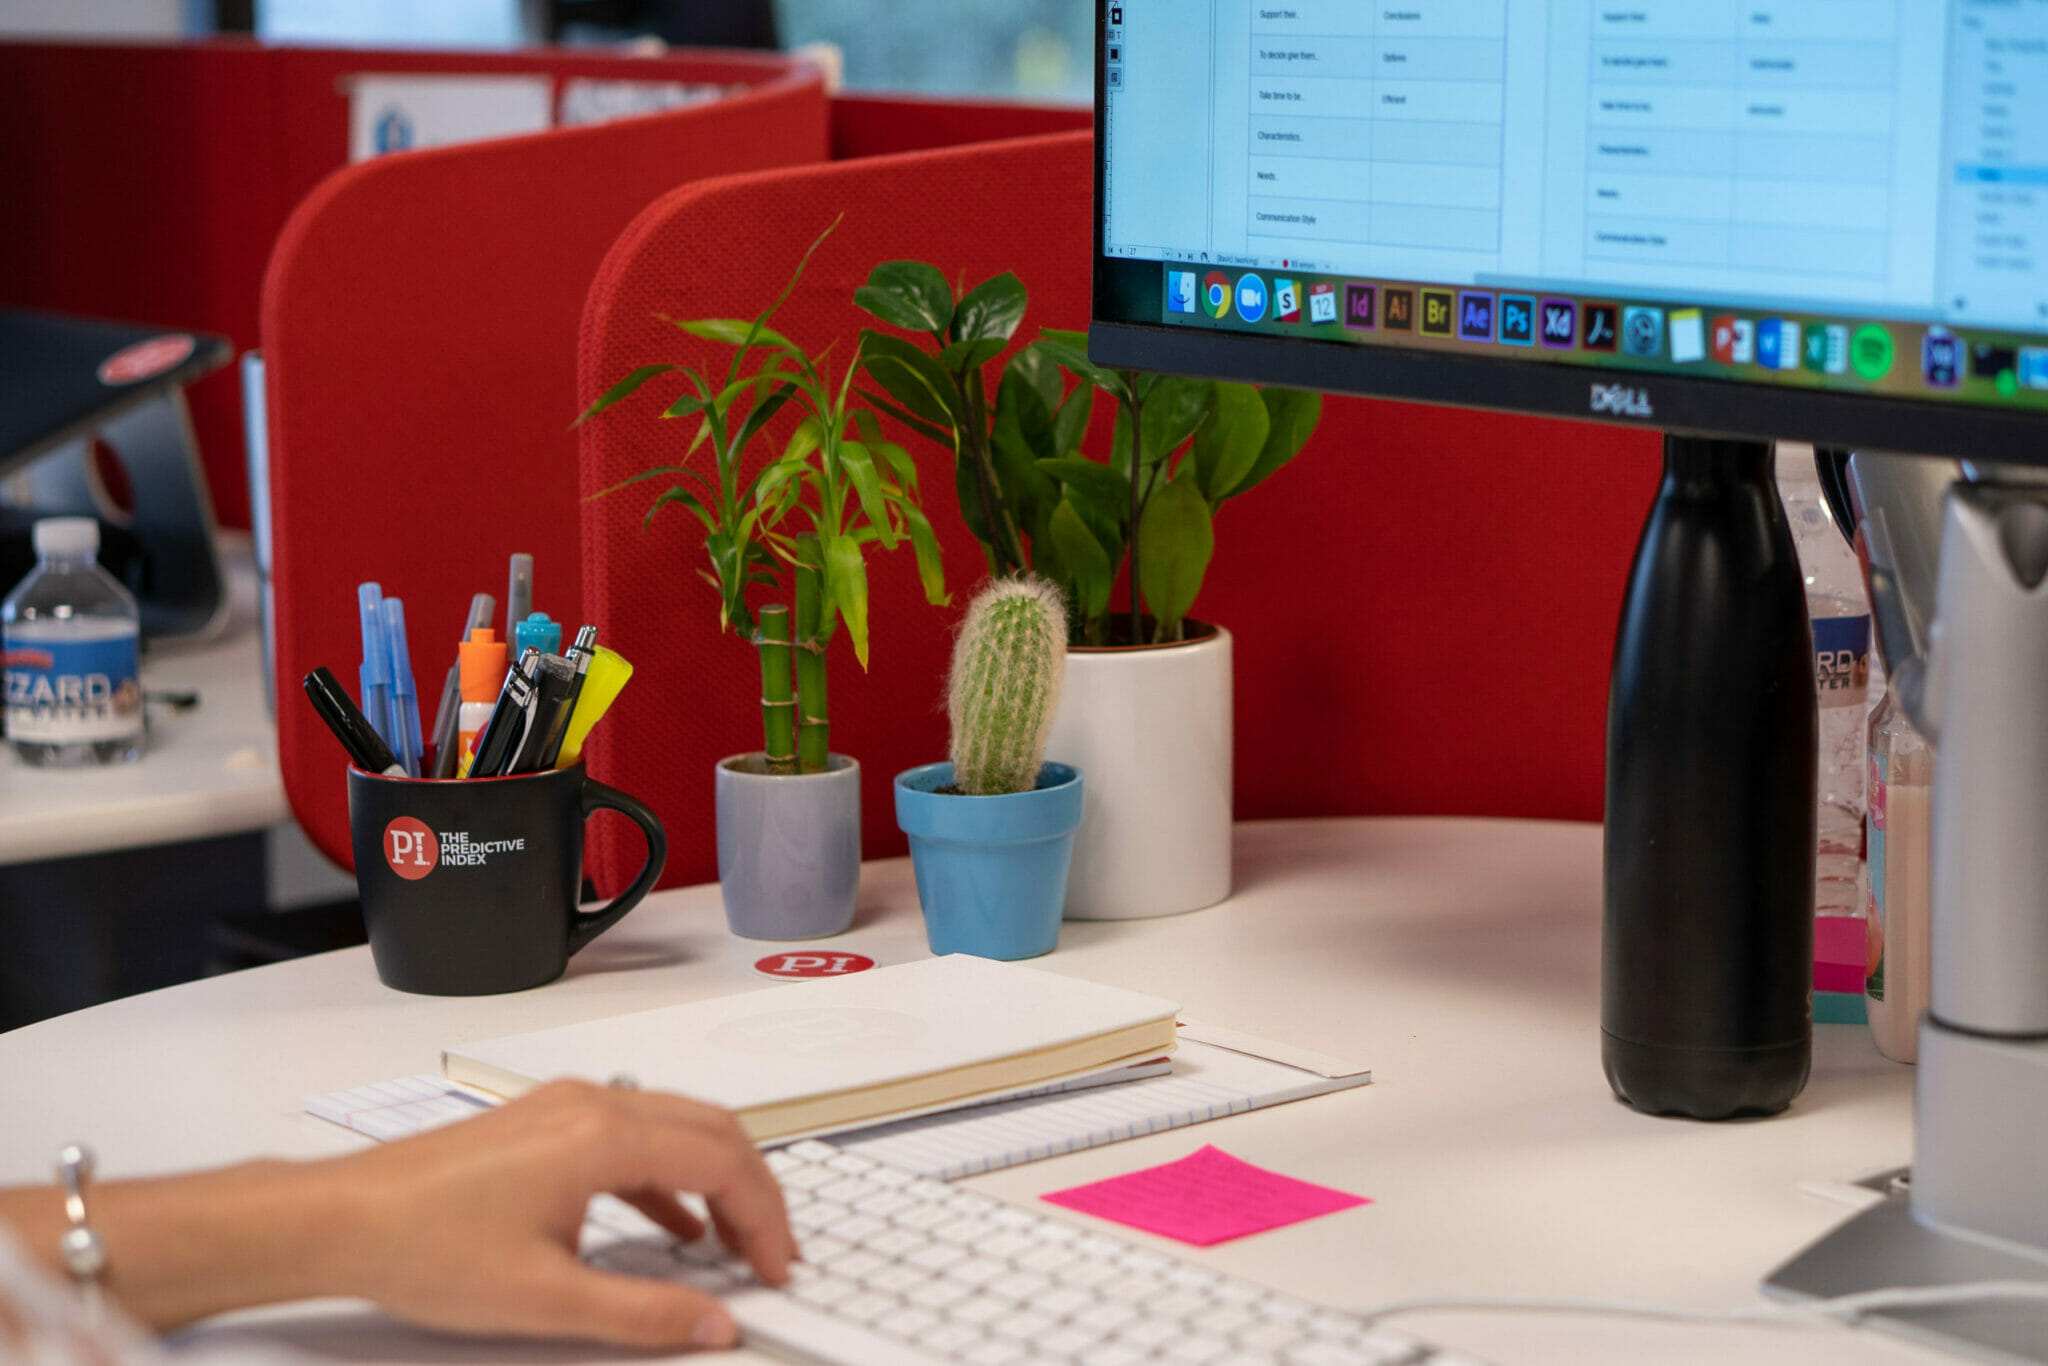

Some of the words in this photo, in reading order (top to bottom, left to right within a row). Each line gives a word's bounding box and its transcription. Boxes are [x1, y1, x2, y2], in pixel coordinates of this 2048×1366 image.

[1282, 292, 1291, 309] S
[1314, 297, 1331, 316] 12
[1351, 292, 1369, 318] Id
[1388, 295, 1408, 321] Ai
[1427, 298, 1447, 324] Br
[1464, 302, 1489, 329] Ae
[1505, 304, 1529, 333] Ps
[1545, 307, 1571, 337] Xd
[1589, 384, 1654, 416] DELL
[440, 832, 469, 844] THE
[441, 838, 525, 856] PREDICTIVE
[441, 853, 487, 867] INDEX
[773, 956, 856, 973] PI
